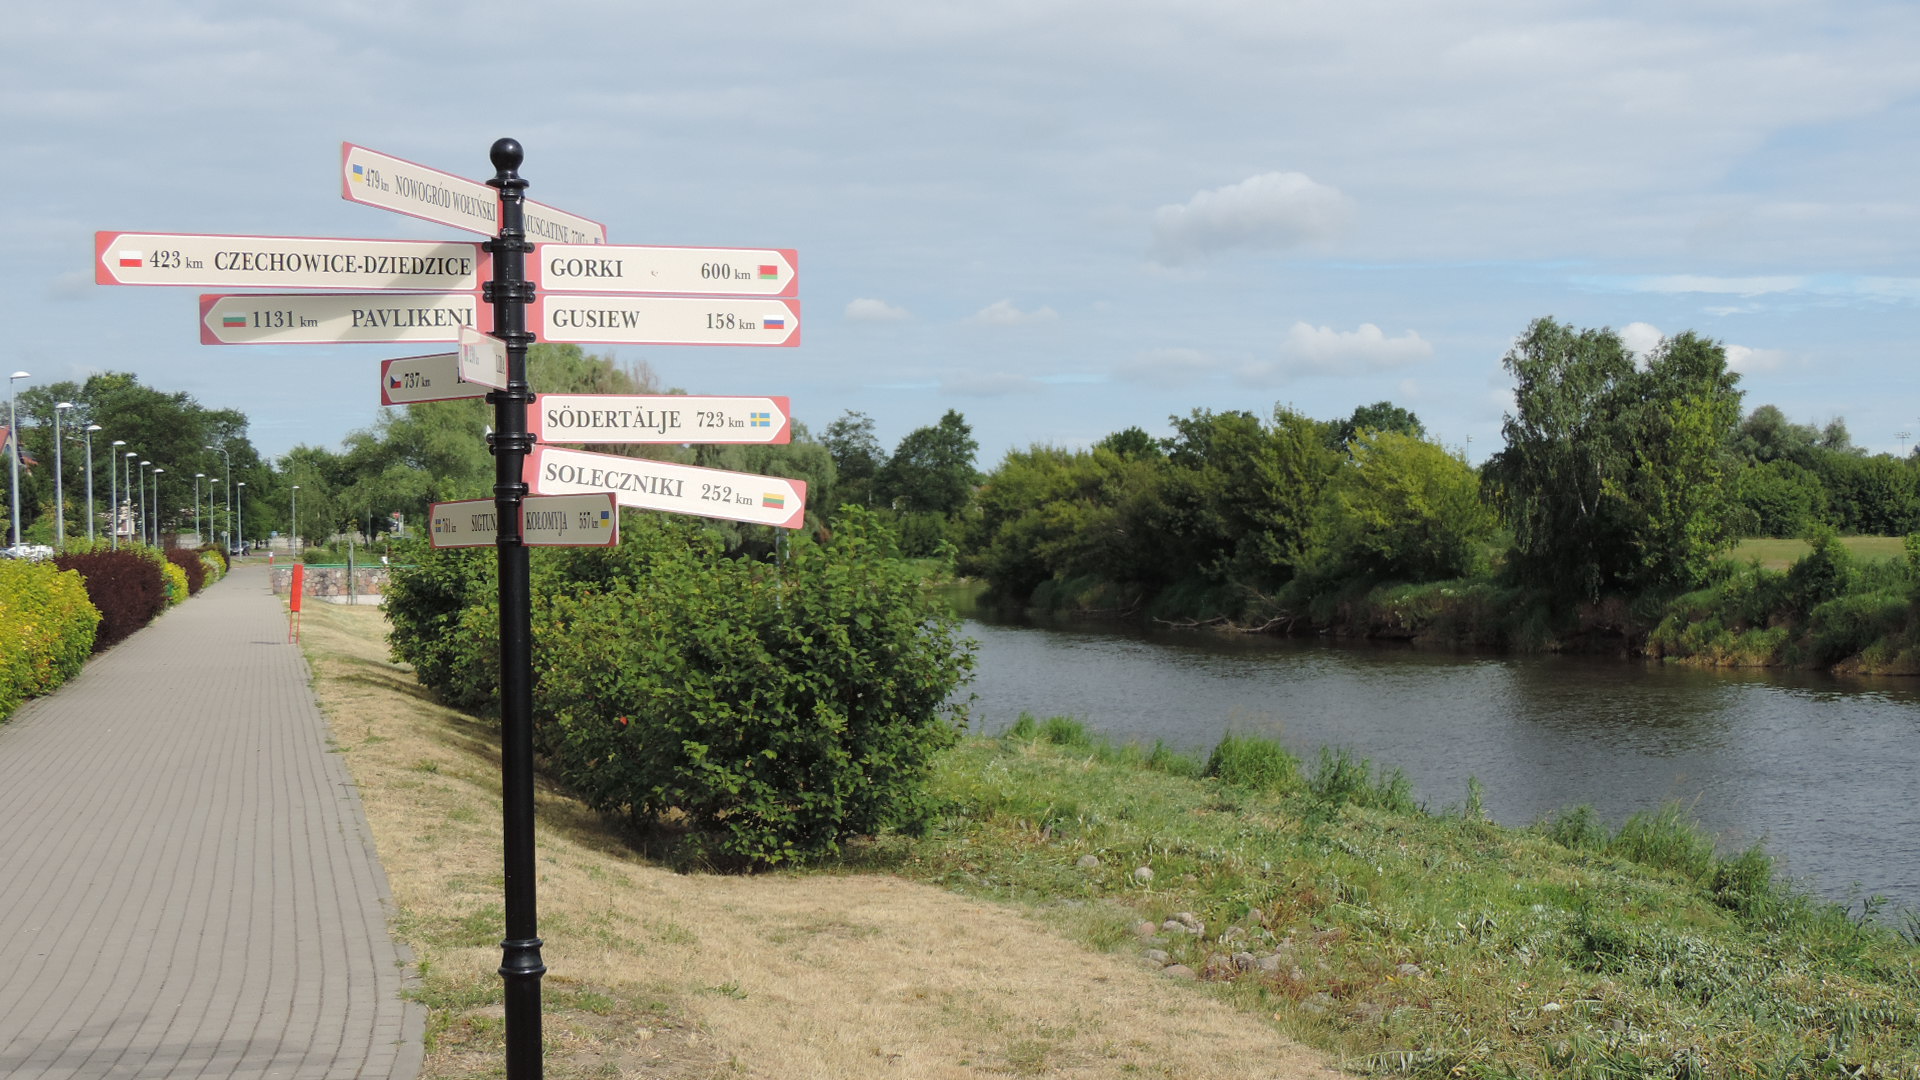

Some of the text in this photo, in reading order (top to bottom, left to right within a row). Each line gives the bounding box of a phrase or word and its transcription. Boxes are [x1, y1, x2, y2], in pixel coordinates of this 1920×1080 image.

[366, 168, 380, 190] 479
[380, 178, 390, 192] km
[395, 174, 450, 209] NOWOGRÓD
[523, 213, 568, 244] MUSCATINE
[149, 250, 472, 276] 423 km CZECHOWICE-DZIEDZICE
[550, 258, 751, 280] GORKI 600 km
[253, 308, 473, 328] 1131 km PAVLIKENI
[552, 308, 755, 330] GUSIEW 158 km
[404, 371, 420, 389] 737
[547, 405, 744, 434] SÖDERTÄLJE 723 km
[545, 462, 753, 506] SOLECZNIKI 252 km
[471, 513, 499, 532] SIGTUN
